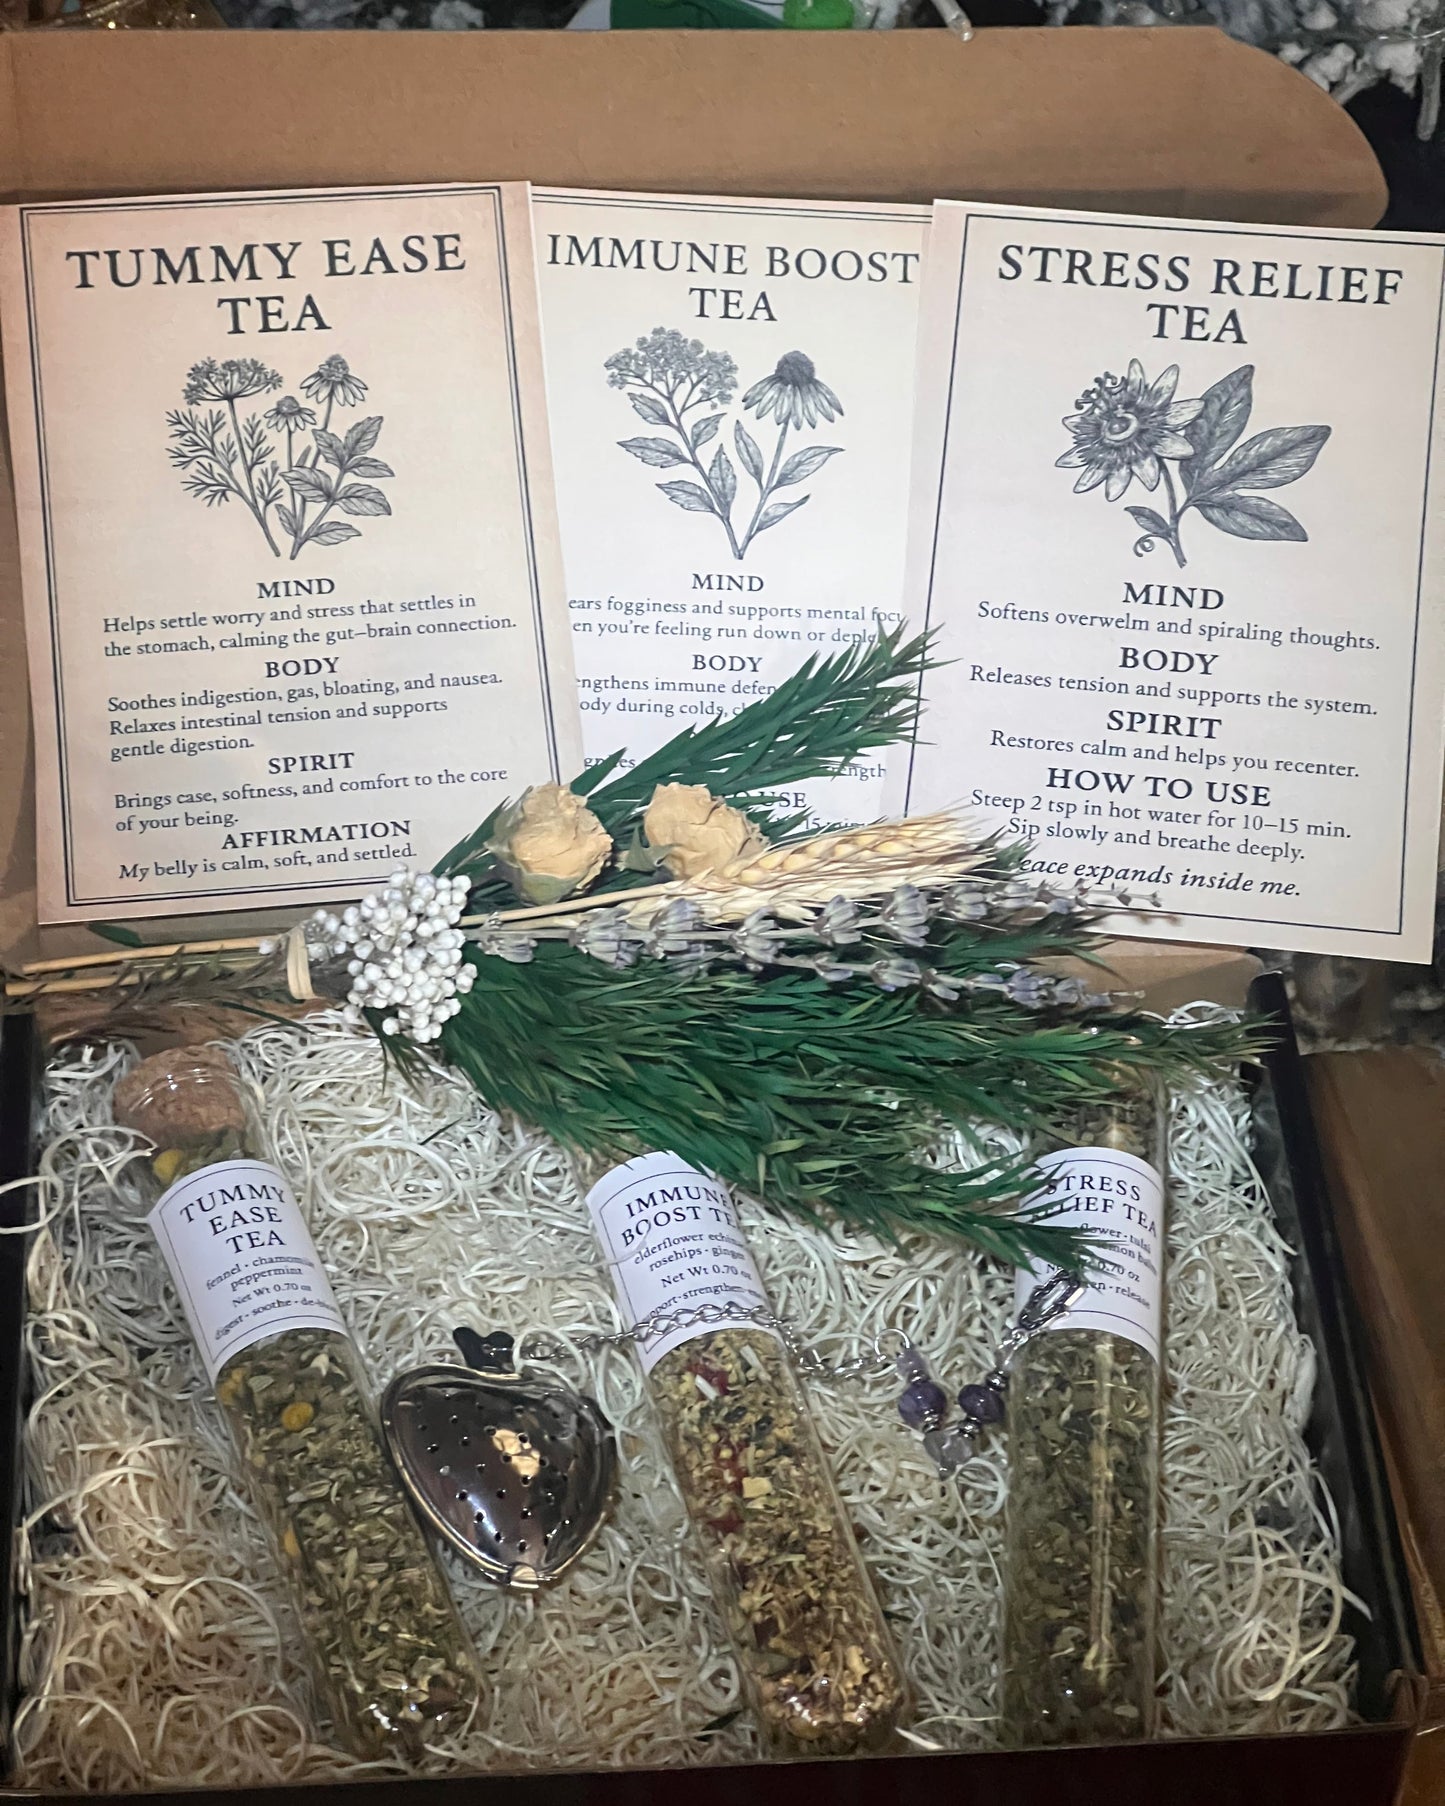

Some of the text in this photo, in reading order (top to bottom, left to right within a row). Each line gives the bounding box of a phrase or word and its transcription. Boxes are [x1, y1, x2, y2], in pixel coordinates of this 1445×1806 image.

[66, 233, 467, 289] TUMMY EASE
[547, 233, 920, 284] IMMUNE BOOST
[998, 244, 1403, 305] STRESS RELIEF
[217, 294, 332, 335] TEA
[689, 287, 778, 322] TEA
[1147, 303, 1248, 345] TEA
[257, 578, 335, 599] MIND
[691, 573, 764, 592] MIND
[1122, 582, 1225, 610] MIND
[103, 594, 476, 635] Helps settle worry and stress that settles in
[568, 599, 602, 610] ears
[607, 596, 687, 616] fogginess
[692, 600, 723, 615] and
[728, 604, 801, 620] supports
[807, 606, 865, 620] mental
[104, 642, 131, 657] the
[136, 636, 215, 655] stomach,
[219, 631, 288, 648] calming
[293, 628, 320, 643] the
[416, 615, 517, 634] connection.
[573, 622, 592, 632] en
[655, 621, 712, 641] feeling
[717, 627, 747, 638] run
[753, 625, 801, 641] down
[807, 631, 825, 642] or
[978, 601, 1380, 652] Softens overwelm and spiraling thoughts.
[264, 657, 339, 678] BODY
[692, 654, 763, 673] BODY
[1119, 646, 1219, 675] BODY
[108, 673, 502, 712] Soothes indigestion, gas, bloating, and nausea.
[575, 675, 778, 695] ngthens immune defen
[969, 665, 1378, 716] Releases tension and supports the system.
[110, 700, 447, 735] Relaxes intestinal tension and supports
[579, 697, 611, 715] ody
[616, 698, 675, 717] during
[679, 700, 728, 718] colds,
[1107, 710, 1223, 739] SPIRIT
[110, 736, 254, 762] gentle digestion.
[268, 752, 354, 774] SPIRIT
[990, 730, 1359, 777] Restores calm and helps you recenter.
[115, 793, 172, 811] Brings
[222, 784, 298, 801] softness,
[302, 778, 334, 795] and
[339, 773, 409, 792] comfort
[414, 775, 432, 787] to
[437, 769, 465, 784] the
[471, 769, 508, 782] core
[1046, 767, 1271, 807] HOW TO USE
[115, 811, 239, 834] of your being.
[971, 789, 1025, 814] Steep
[1030, 795, 1042, 811] 2
[1049, 800, 1077, 818] tsp
[1084, 800, 1102, 816] in
[1109, 801, 1141, 819] hot
[1148, 808, 1202, 825] water
[1207, 809, 1236, 829] for
[1306, 821, 1351, 838] min.
[221, 821, 412, 850] AFFIRMATION
[1009, 817, 1305, 863] Sip slowly and breathe deeply.
[119, 843, 417, 882] My belly is calm, soft, and settled.
[1020, 859, 1300, 896] eace expands inside me.
[179, 1183, 286, 1224] TUMMY
[626, 1186, 732, 1219] IMMUNE
[1040, 1197, 1157, 1238] LIEF TEA
[208, 1206, 283, 1236] EASE
[621, 1206, 737, 1248] BOOST TE
[226, 1229, 287, 1254] TEA
[635, 1233, 703, 1264] elderflower
[649, 1247, 703, 1272] rosehips
[660, 1272, 685, 1288] Net
